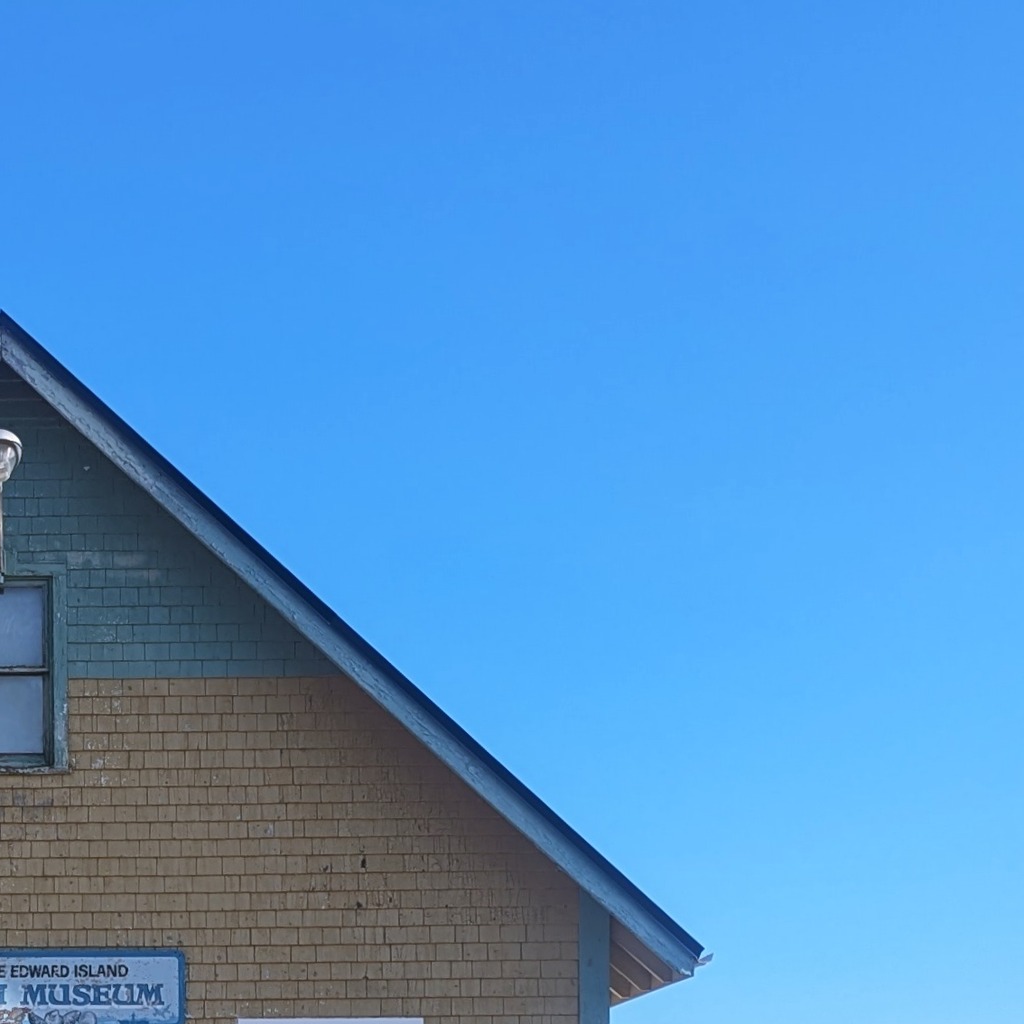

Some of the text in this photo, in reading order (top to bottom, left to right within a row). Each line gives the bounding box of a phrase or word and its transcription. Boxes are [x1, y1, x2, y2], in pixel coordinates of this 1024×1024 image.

[10, 964, 70, 978] EDWARD
[74, 964, 129, 978] ISLAND
[20, 983, 164, 1006] MUSEUM
